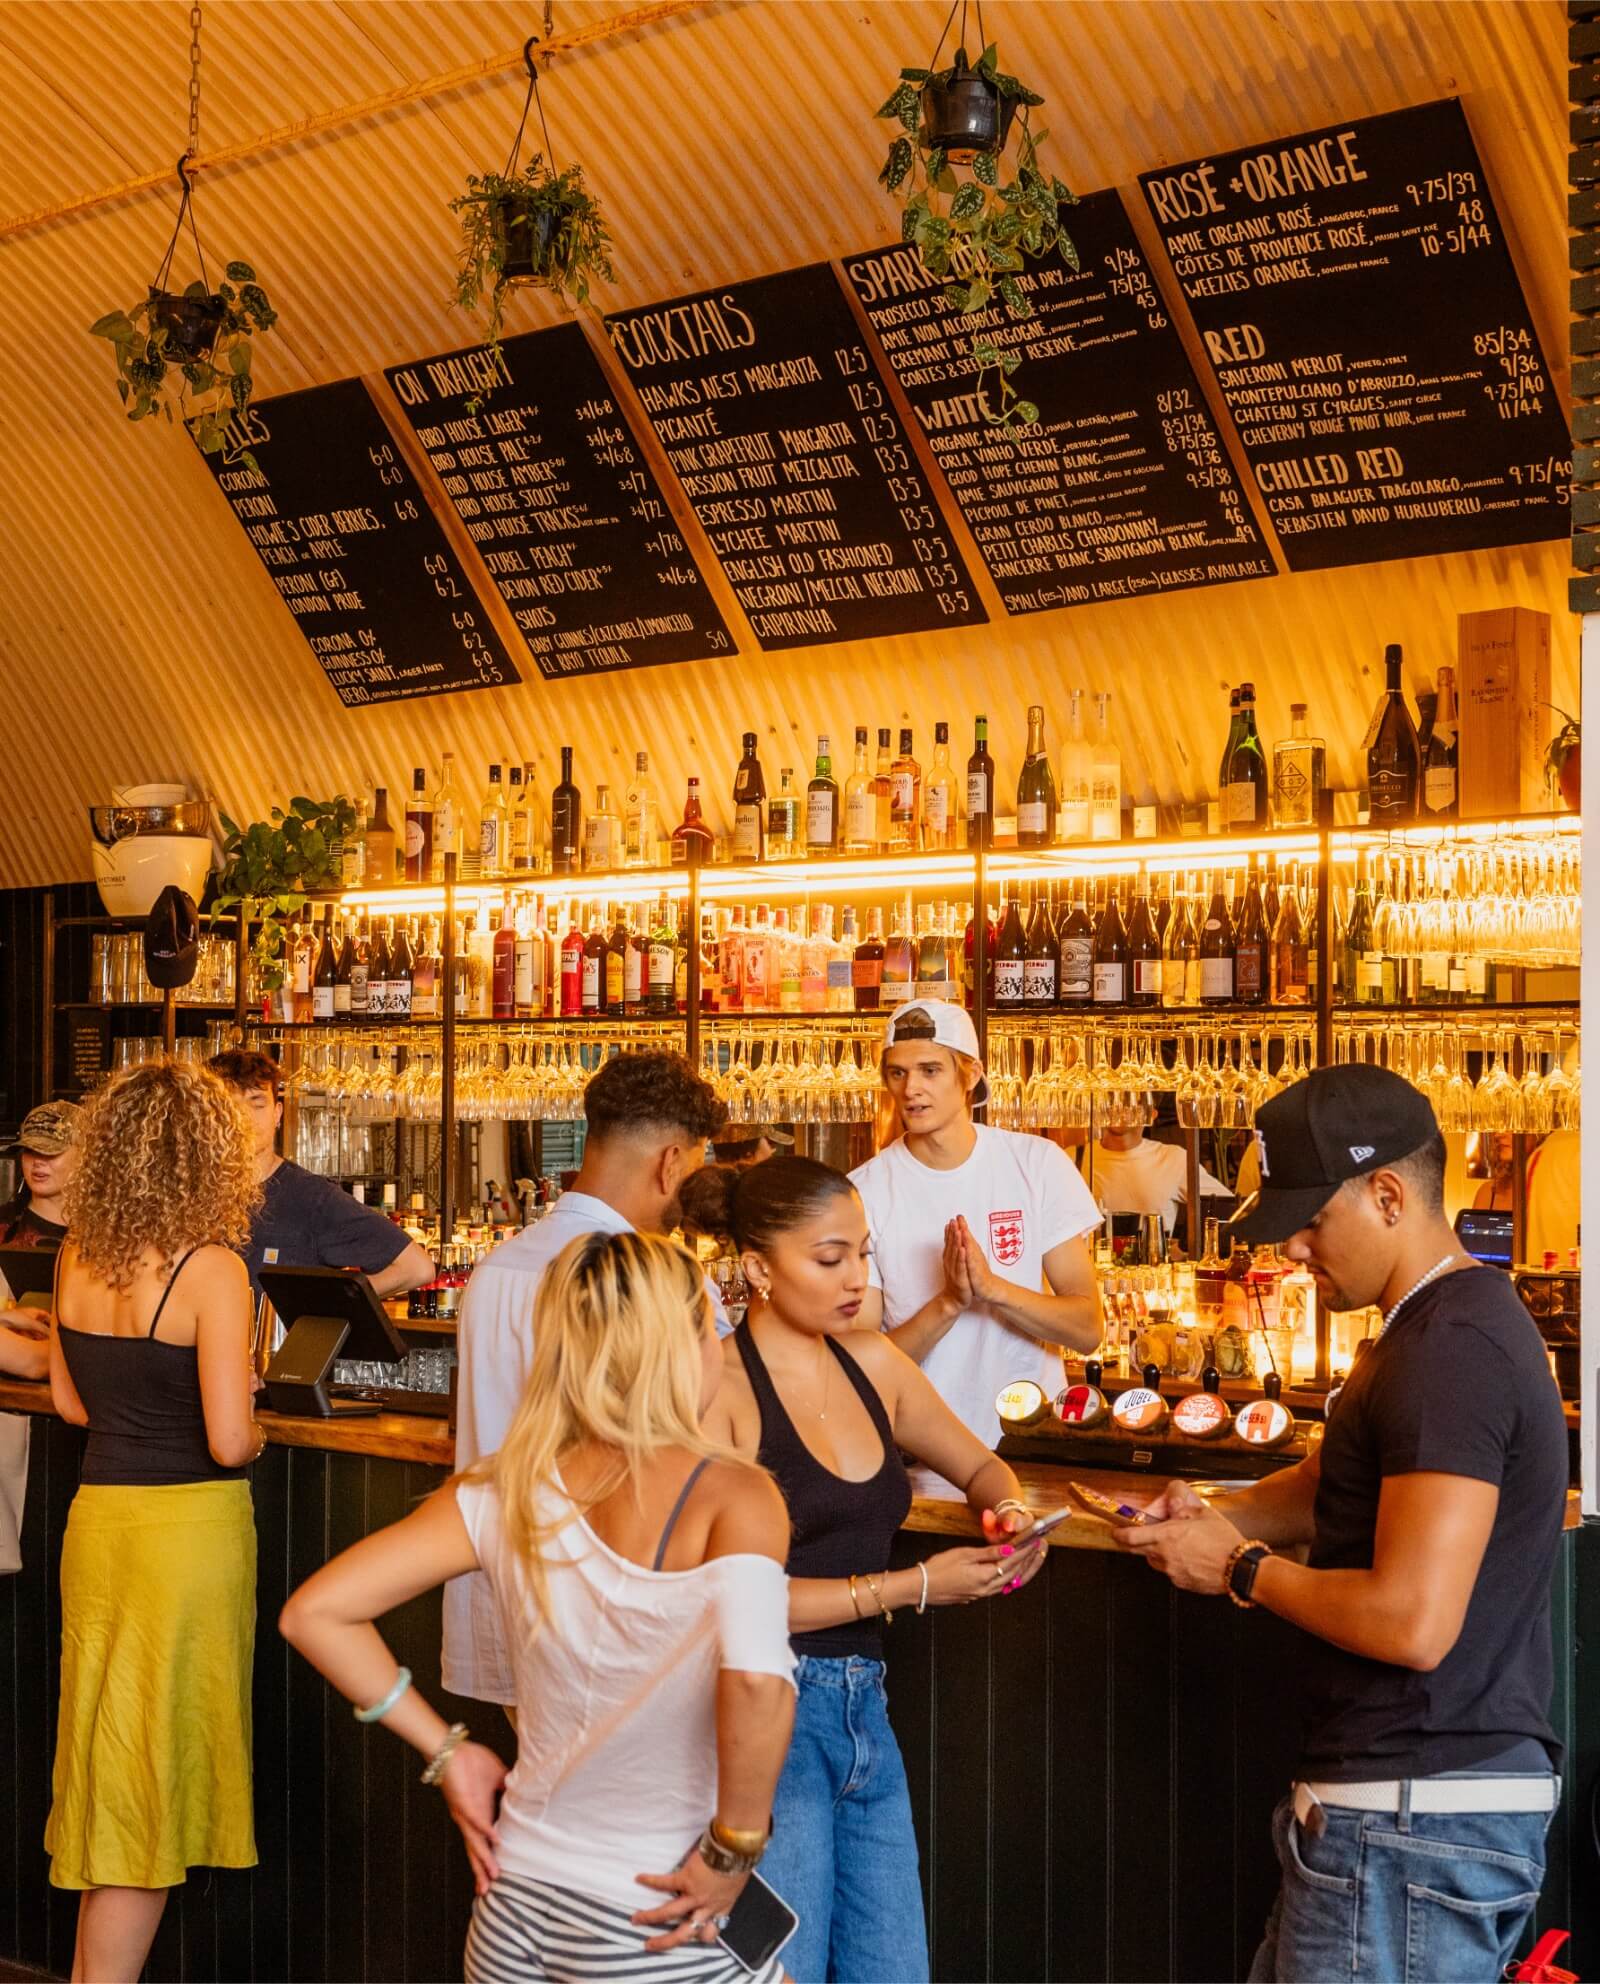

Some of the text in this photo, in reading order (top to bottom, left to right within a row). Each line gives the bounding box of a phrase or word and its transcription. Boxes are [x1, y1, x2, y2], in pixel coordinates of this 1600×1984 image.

[1148, 162, 1225, 223] ROSÉ
[1168, 231, 1206, 255] AMIE
[1209, 216, 1275, 246] ORGANIC
[1176, 253, 1224, 276] CÔTES
[1226, 247, 1247, 266] DE
[1249, 232, 1325, 262] PROVENCE
[1458, 200, 1484, 227] 48
[868, 248, 1141, 329] PROSECCO 9/36
[1184, 271, 1250, 298] WEEZIES
[614, 295, 755, 368] COCKTAILS
[881, 308, 1004, 350] AMIE NON ALCOHOLIC
[891, 292, 1156, 369] CREMANT DE 45
[1204, 324, 1265, 364] RED
[900, 313, 1166, 387] COATES 66
[395, 346, 514, 405] ON DRAUGHT
[639, 347, 867, 413] HAWKS NEST MARGARITA 12.5
[1219, 363, 1288, 388] SAVERONI
[1225, 355, 1538, 408] MONTEPULCIANO 9/36
[417, 410, 526, 448] BIRD HOUSE LAGER
[654, 382, 882, 443] PICANTÉ 12.5
[914, 391, 991, 430] WHITE
[930, 389, 1193, 452] ORGANIC 8/32
[1235, 405, 1296, 423] CHATEAU
[1302, 403, 1316, 417] ST
[1243, 397, 1542, 445] CHEVERNY ROUGE PINOT 11/44
[431, 438, 530, 472] BIRD HOUSE PALE
[668, 413, 896, 473] PINK GRAPEFRUIT MARGARITA 12.5
[939, 452, 972, 469] ORLA
[973, 445, 1014, 462] VINHO
[219, 445, 393, 491] CORONA 6.0
[442, 461, 556, 496] BIRD HOUSE AMBER
[681, 444, 909, 497] PASSION FRUIT MEZCALITA 13.5
[948, 458, 1059, 486] GOOD HOPE CHENIN
[957, 450, 1221, 505] AMIE SAUVIGNON 9/36
[1256, 447, 1403, 492] CHILLED RED
[233, 467, 403, 518] PERONI 6.0
[454, 485, 558, 518] BIRD HOUSE STOUT
[695, 477, 920, 525] ESPRESSO MARTINI 13.5
[965, 500, 1031, 523] PICPOUL DE
[1269, 488, 1375, 512] CASA BALAGUER
[247, 500, 418, 546] HOWIE'S CIDER 6.8
[467, 522, 494, 542] BIRD
[492, 515, 533, 537] HOUSE
[530, 506, 581, 532] TRACKS
[708, 506, 935, 554] LYCHEE MARTINI 13.5
[975, 490, 1238, 541] GRAN CERDO 40
[983, 507, 1244, 561] PETIT CHABLIS 46
[1276, 507, 1389, 534] SEBASTIEN DAVID
[260, 547, 298, 564] PEACH
[309, 539, 347, 559] APPLE
[484, 544, 572, 574] JUBEL PEACH
[723, 537, 947, 581] ENGLISH OLD FASHIONED 13.5
[991, 525, 1256, 578] SANCERRE BLANC SAUVIGNON 49
[1208, 560, 1269, 579] AVAILABLE
[275, 554, 447, 594] PERONI (GF) 6.0
[498, 569, 602, 599] DEVON RED CIDER
[862, 563, 957, 596] NEGRONI 13.5
[287, 578, 462, 614] LONDON PRIDE 6.2
[751, 591, 969, 637] CAIPIRINHA 13.5
[310, 612, 474, 653] CORONA 6.0
[516, 607, 556, 629] SHOTS
[320, 633, 485, 669] GUINNESS 6.2
[528, 636, 553, 653] BABY
[540, 657, 558, 673] EL
[556, 652, 584, 670] RAYO
[586, 646, 631, 666] TEQUILA
[329, 651, 492, 685] LUCKY 6.0
[480, 667, 503, 683] 6.5
[1124, 1390, 1152, 1409] JUBEL
